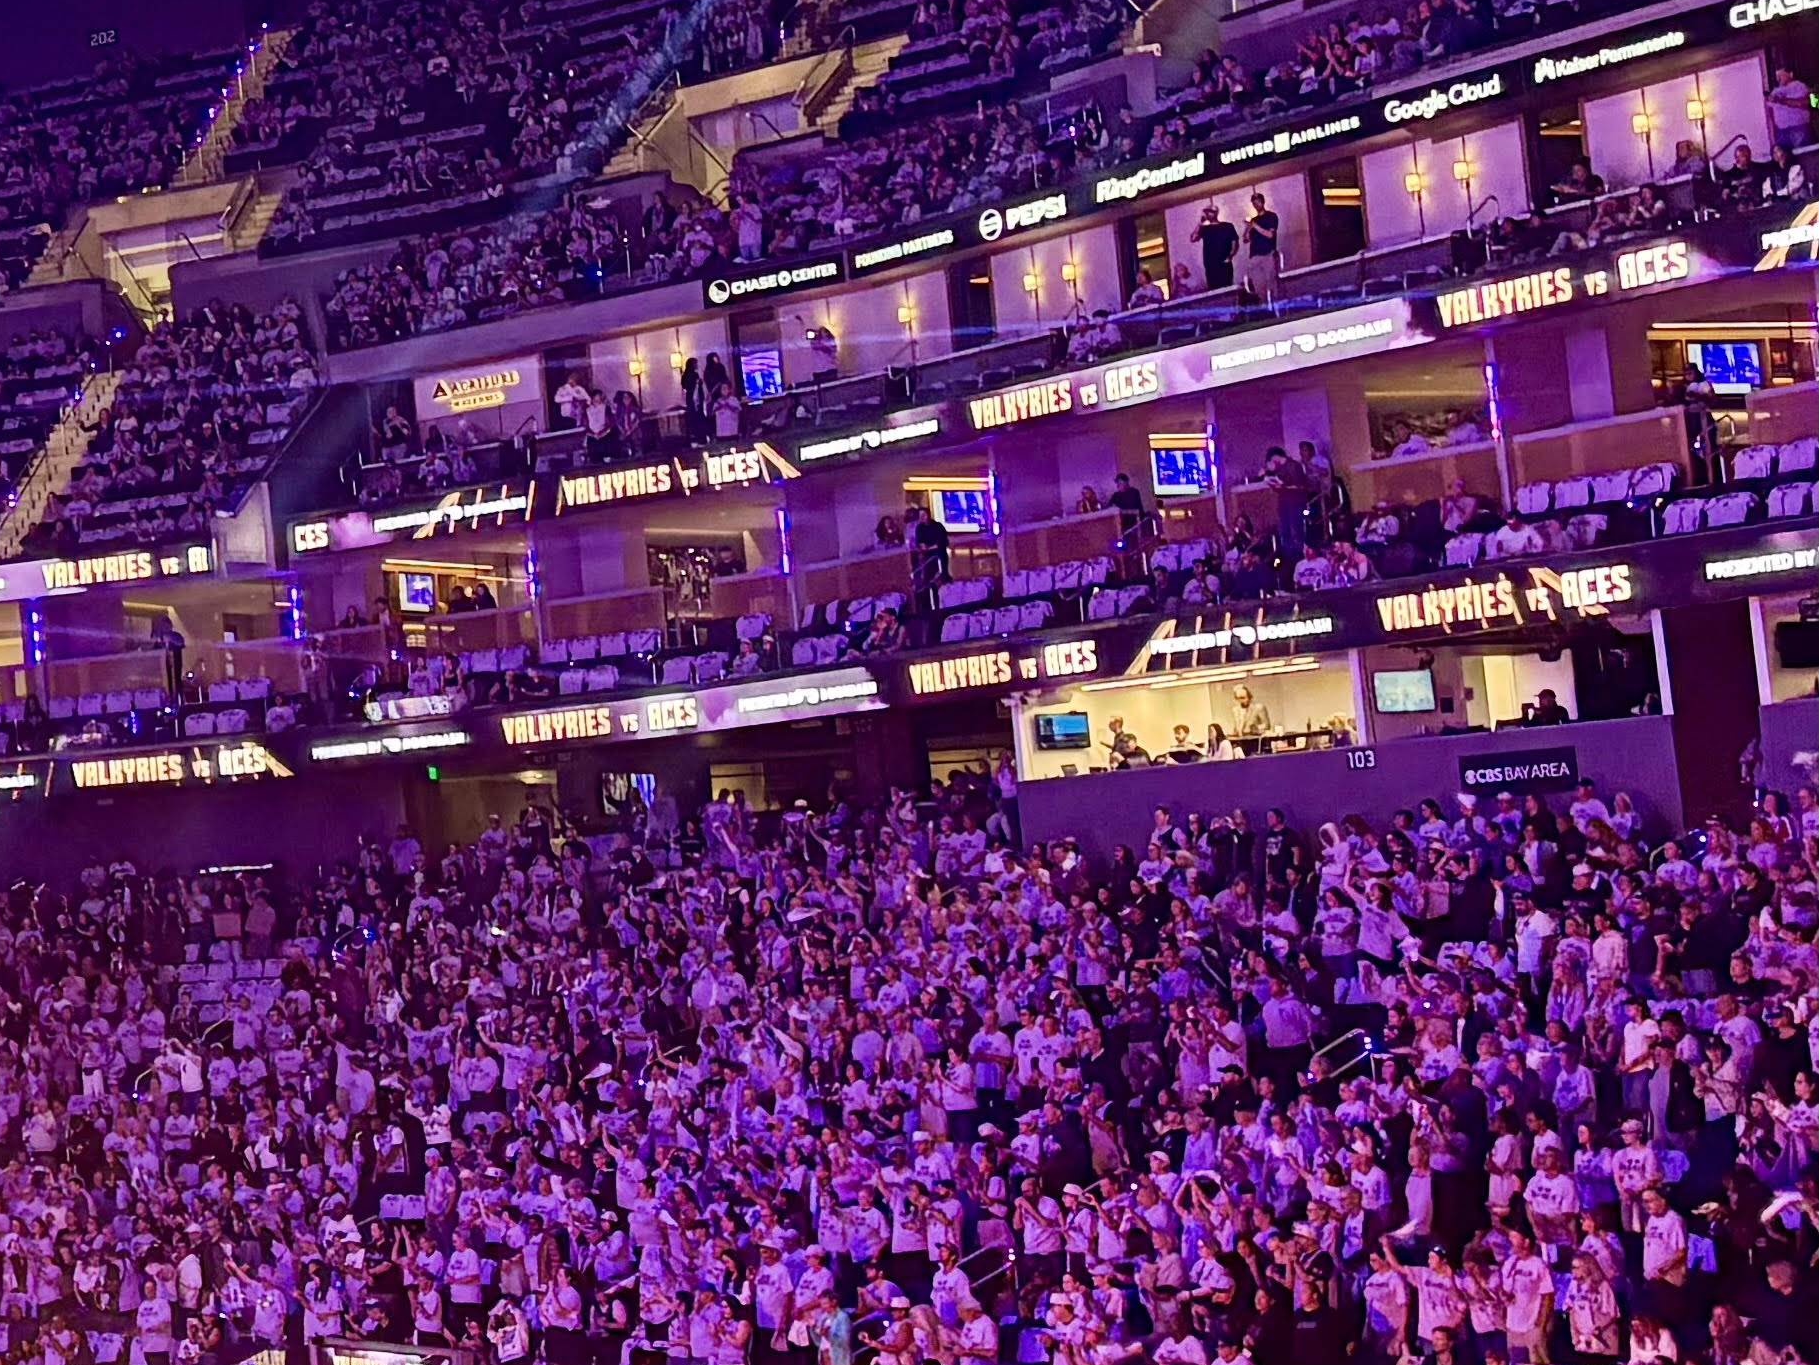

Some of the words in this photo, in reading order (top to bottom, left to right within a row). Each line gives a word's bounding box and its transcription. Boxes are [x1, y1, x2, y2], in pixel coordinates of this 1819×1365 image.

[1384, 88, 1449, 123] Google
[1448, 73, 1501, 106] Cloud
[1220, 139, 1275, 165] UNITED
[1290, 115, 1361, 146] AIRLINES
[1096, 151, 1205, 203] RingCentral
[1005, 193, 1067, 231] PEPSI
[731, 273, 778, 295] CHASE
[791, 262, 838, 283] CENTER
[1436, 267, 1573, 329] VALKYRIES
[1618, 241, 1689, 292] ACES
[970, 378, 1073, 430] VALKYRIES
[1104, 361, 1159, 403] ACES
[561, 464, 672, 507] VALKYRIES
[706, 449, 760, 486] ACES
[42, 552, 153, 590] VALKYRIES
[1376, 579, 1515, 633] VALKYRIES
[1561, 564, 1633, 609] ACES
[908, 651, 1012, 695] VALKYRIES
[1044, 639, 1098, 678] ACES
[501, 707, 612, 745] VALKYRIES
[647, 697, 699, 732] ACES
[72, 753, 183, 788] VALKYRIES
[219, 745, 267, 777] ACES
[1347, 749, 1376, 769] 103
[1476, 767, 1503, 784] CBS
[1504, 764, 1530, 782] BAY
[1531, 761, 1571, 779] AREA
